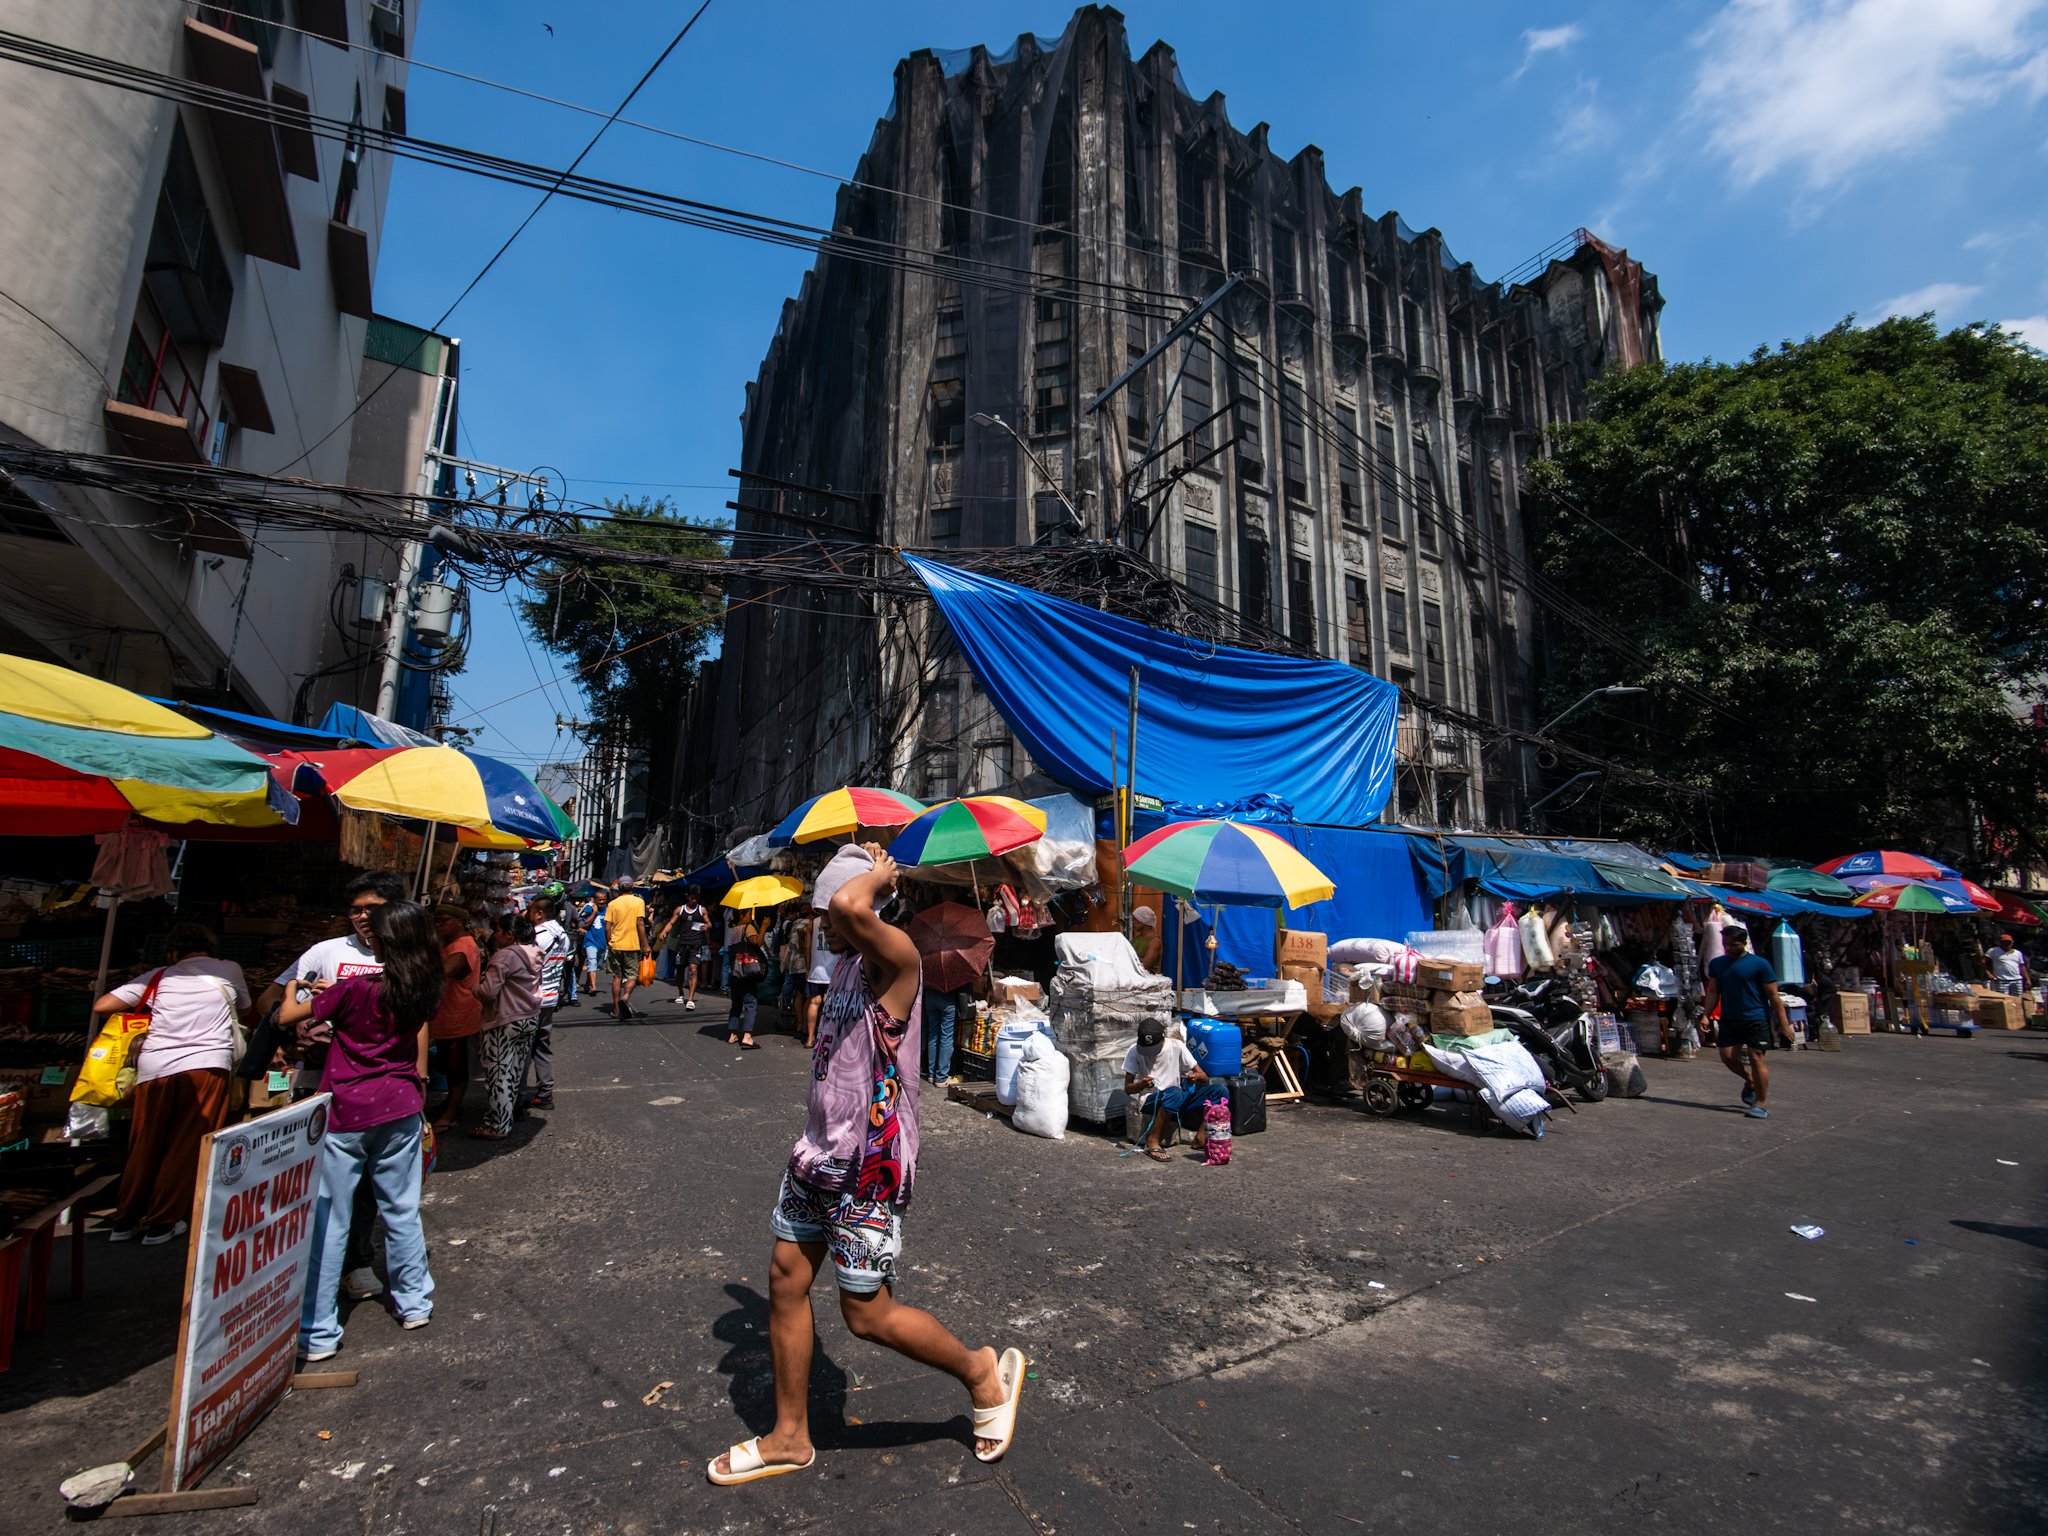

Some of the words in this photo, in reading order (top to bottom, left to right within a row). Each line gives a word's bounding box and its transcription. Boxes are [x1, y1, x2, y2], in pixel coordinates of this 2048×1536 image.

[1290, 936, 1314, 949] 138
[252, 1133, 269, 1149] CITY
[271, 1128, 280, 1141] OF
[283, 1117, 308, 1136] MANILA
[222, 1180, 269, 1241] ONE
[270, 1155, 316, 1215] WAY
[213, 1239, 247, 1300] NO
[252, 1199, 312, 1275] ENTRY
[201, 1344, 240, 1385] VIOLATORS
[240, 1333, 256, 1354] WILL
[257, 1325, 265, 1341] BE
[228, 1329, 243, 1348] AND
[243, 1317, 257, 1338] ANY
[187, 1413, 239, 1473] King
[191, 1389, 241, 1441] Tapa
